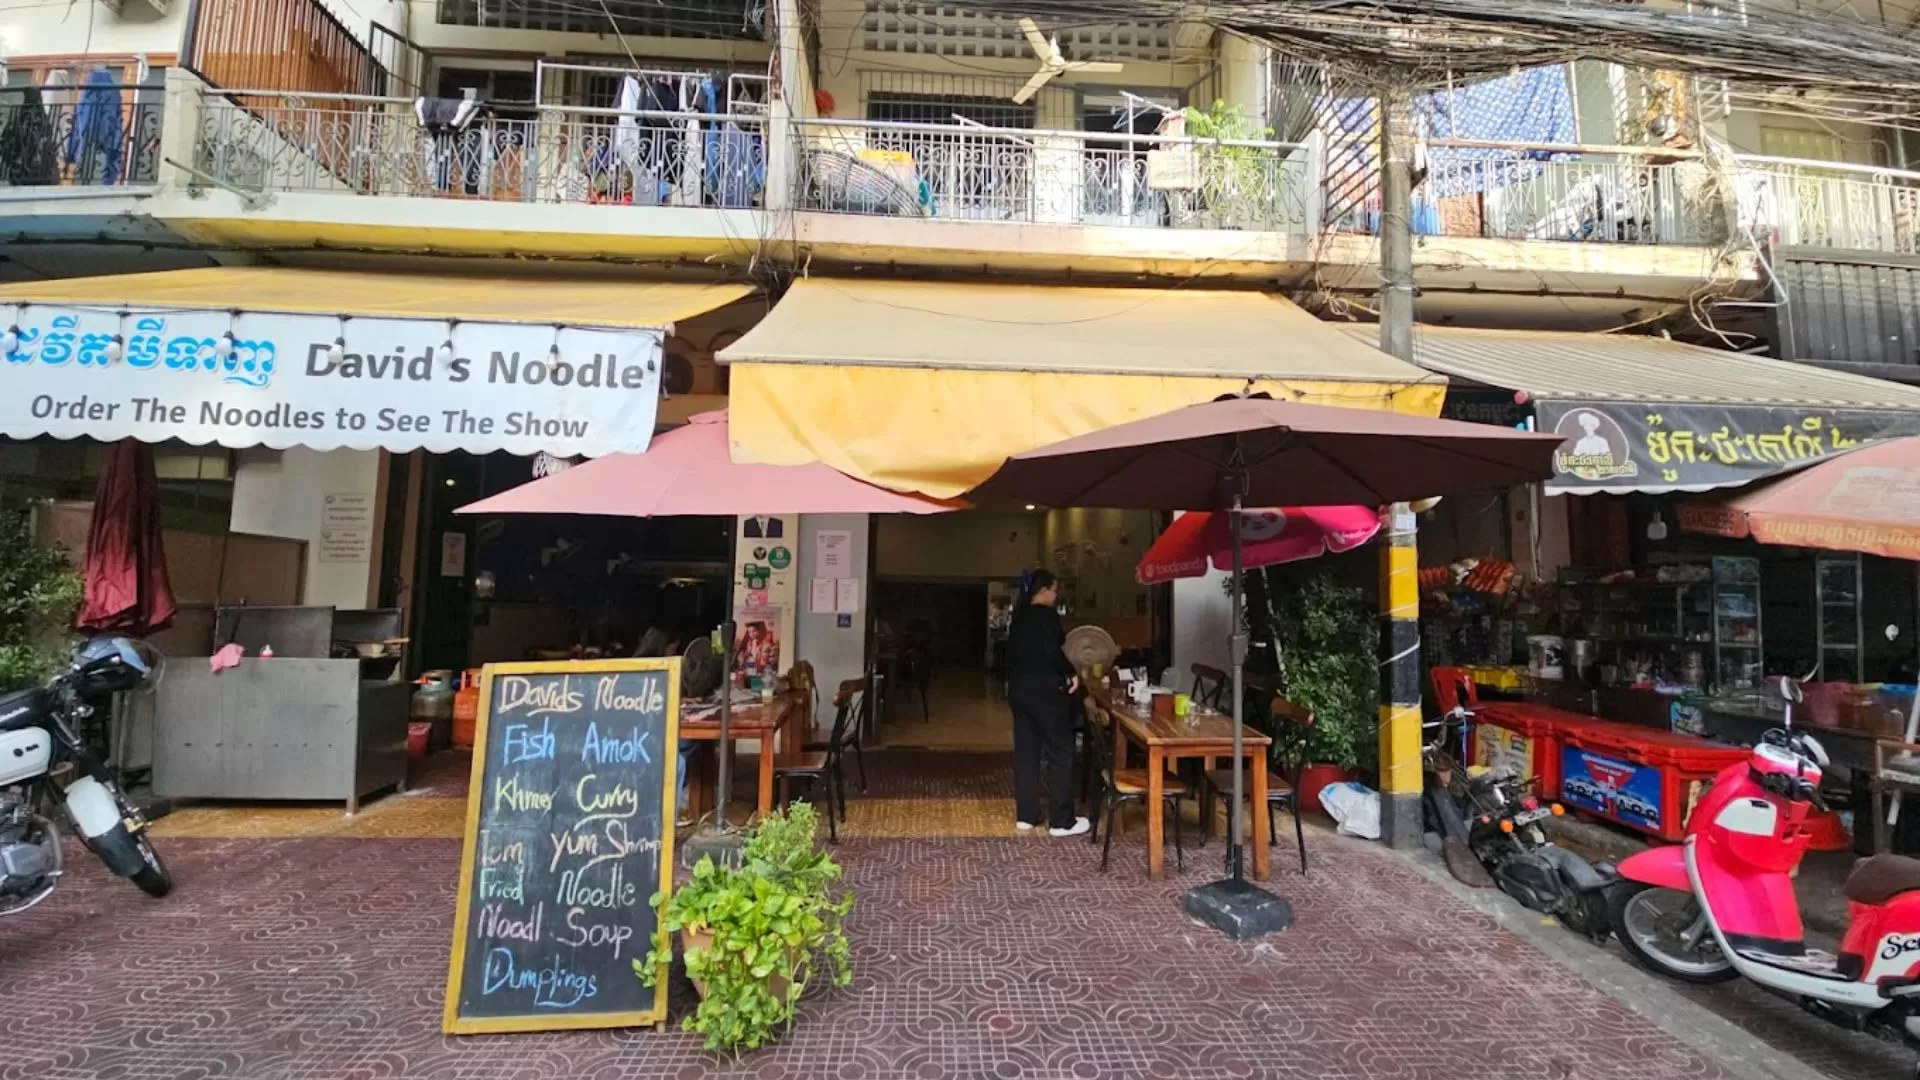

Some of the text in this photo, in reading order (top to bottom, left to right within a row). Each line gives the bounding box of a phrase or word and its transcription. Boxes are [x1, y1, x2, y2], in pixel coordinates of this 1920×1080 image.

[305, 343, 644, 389] Davids Noodle
[31, 394, 588, 437] Order The Noodles to See The Show
[594, 674, 664, 714] Noodle
[503, 717, 556, 768] Fish
[495, 773, 638, 831] Khmer Curry
[479, 863, 636, 909] Fried Noodle
[557, 907, 632, 959] Soup
[1881, 935, 1920, 960] Sc
[483, 948, 598, 1007] Dumplings
